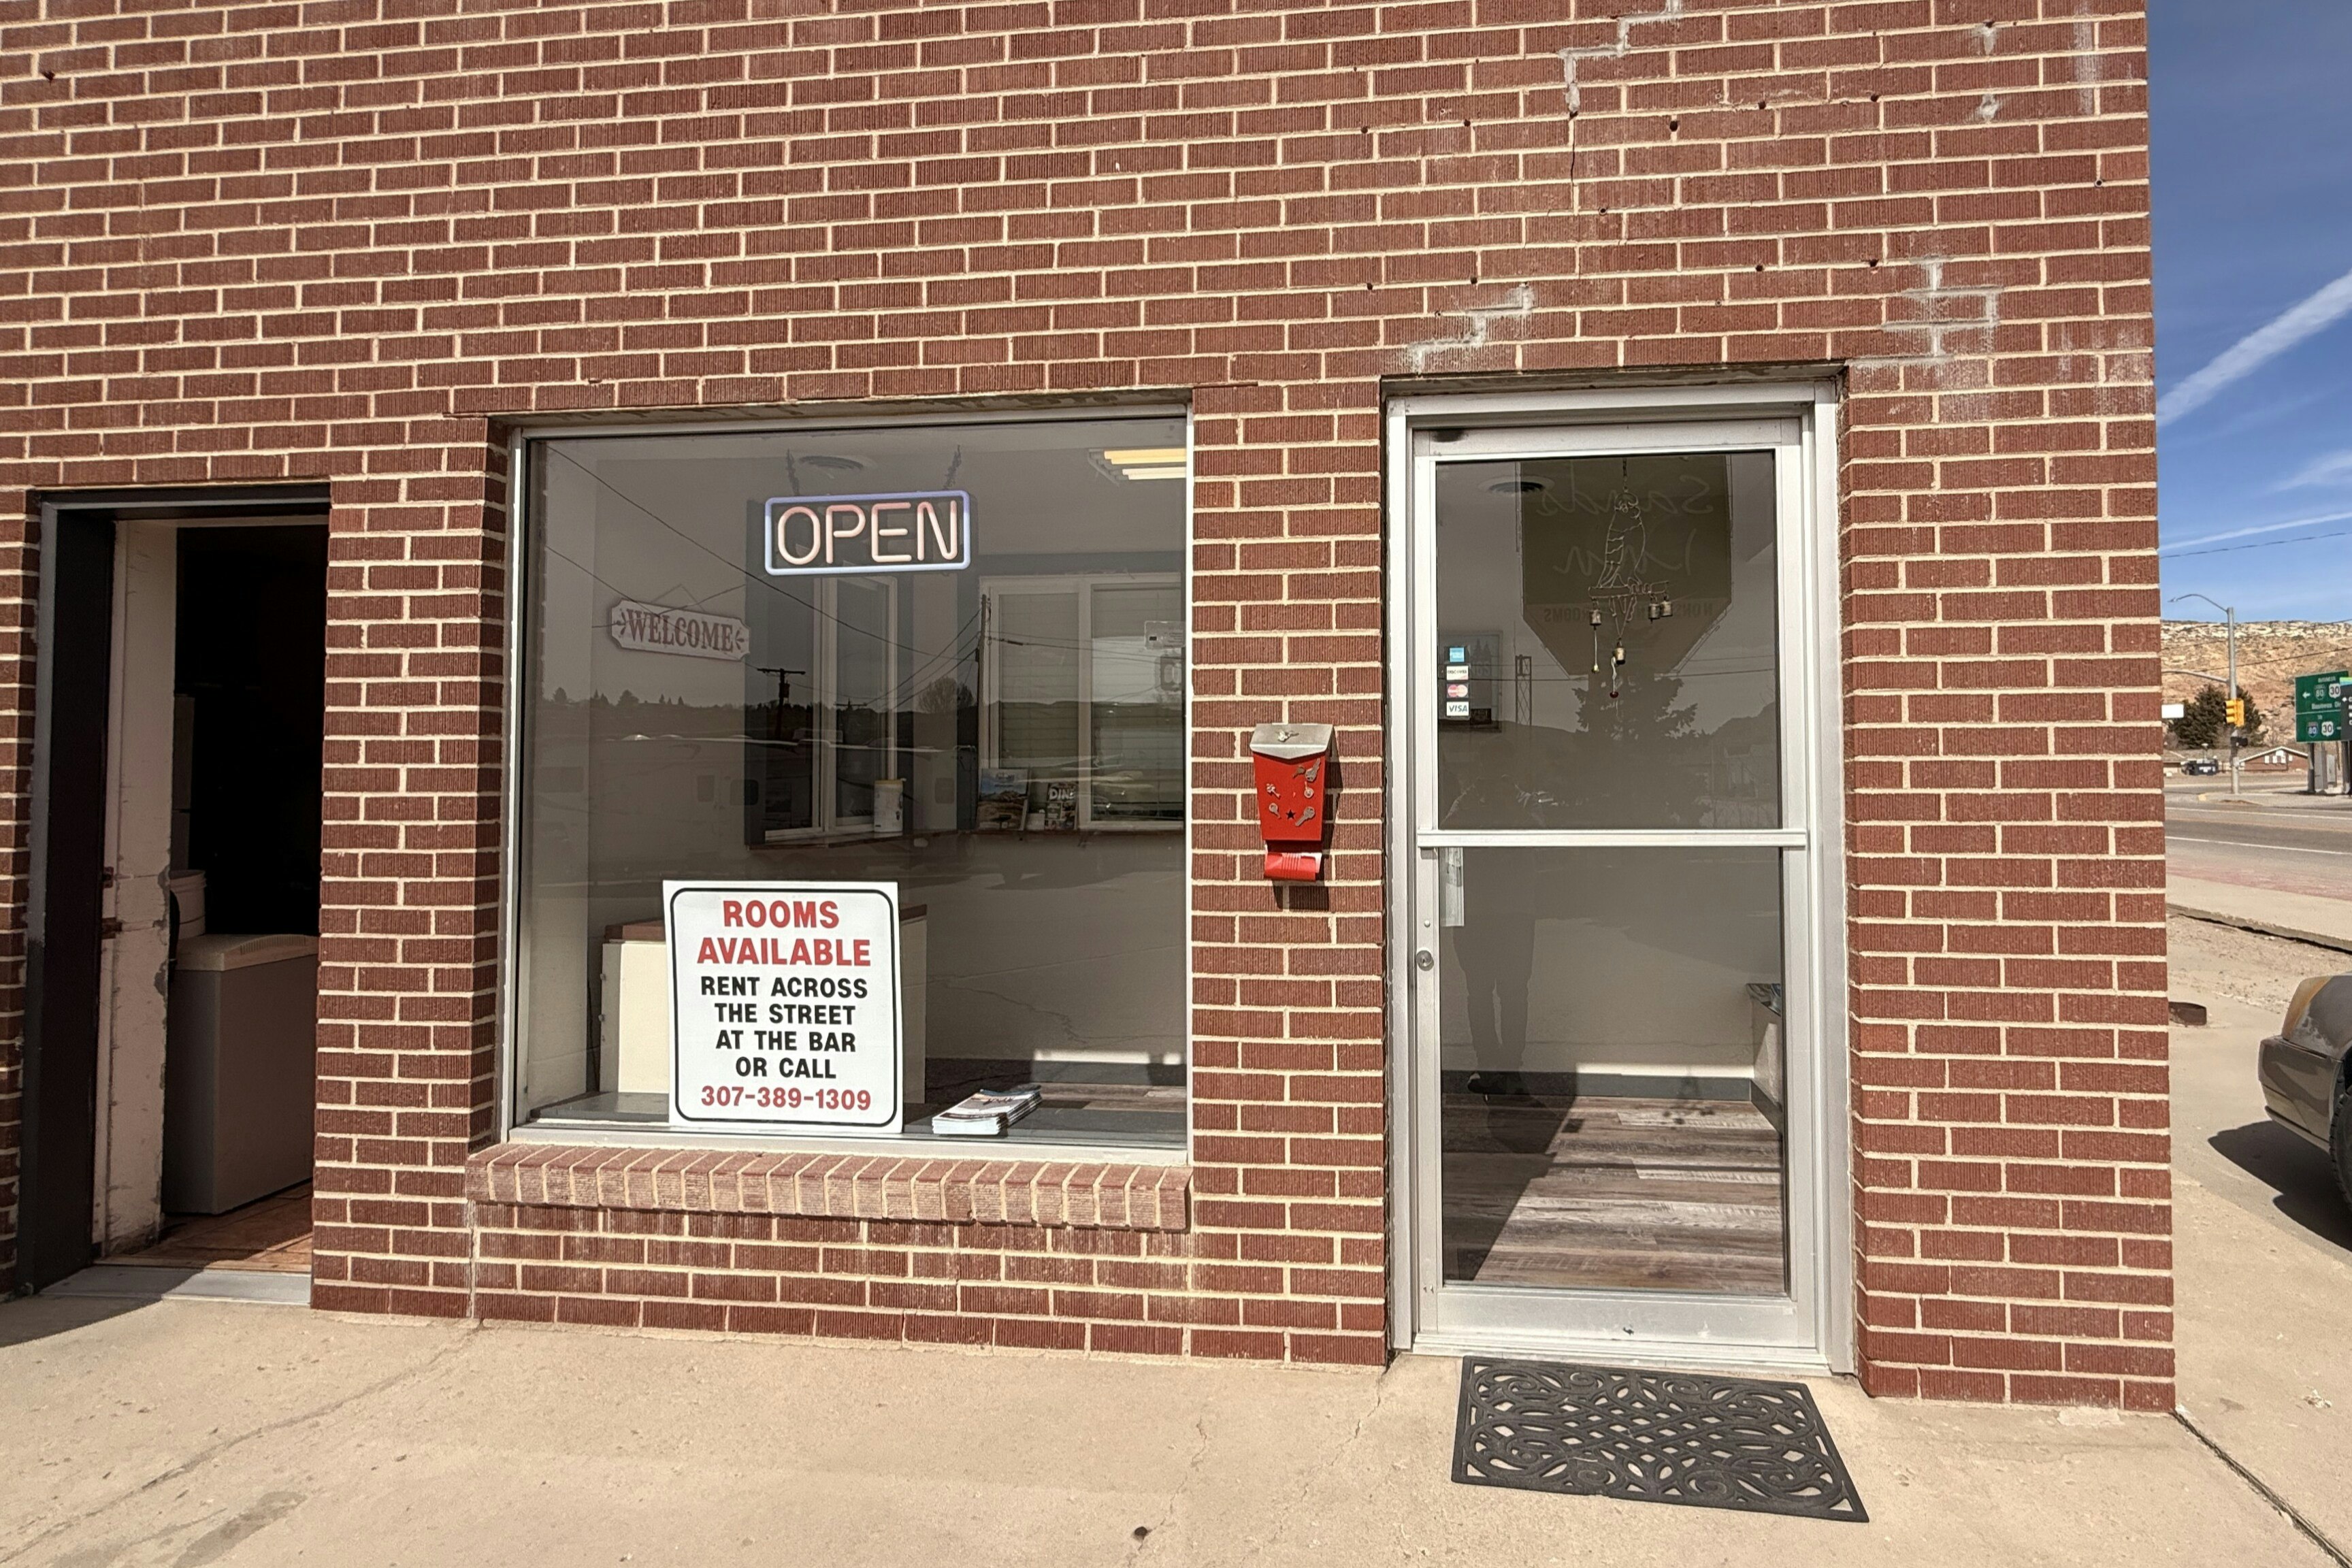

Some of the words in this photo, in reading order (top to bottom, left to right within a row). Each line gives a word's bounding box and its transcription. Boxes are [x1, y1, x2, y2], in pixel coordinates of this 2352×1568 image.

[778, 500, 958, 565] OPEN
[627, 608, 735, 652] WELCOME
[2330, 686, 2340, 696] 30
[1449, 704, 1468, 713] VISA
[2323, 725, 2333, 733] 30
[723, 900, 839, 928] ROOMS
[697, 937, 871, 966] AVAILABLE
[701, 976, 760, 996] RENT
[771, 977, 868, 998] ACROSS
[715, 1003, 757, 1023] THE
[769, 1004, 855, 1025] STREET
[716, 1030, 743, 1049] AT
[755, 1031, 797, 1050] THE
[809, 1032, 855, 1052] BAR
[736, 1057, 767, 1077] OR
[779, 1058, 836, 1079] CALL
[701, 1085, 871, 1111] 307-389-1309
